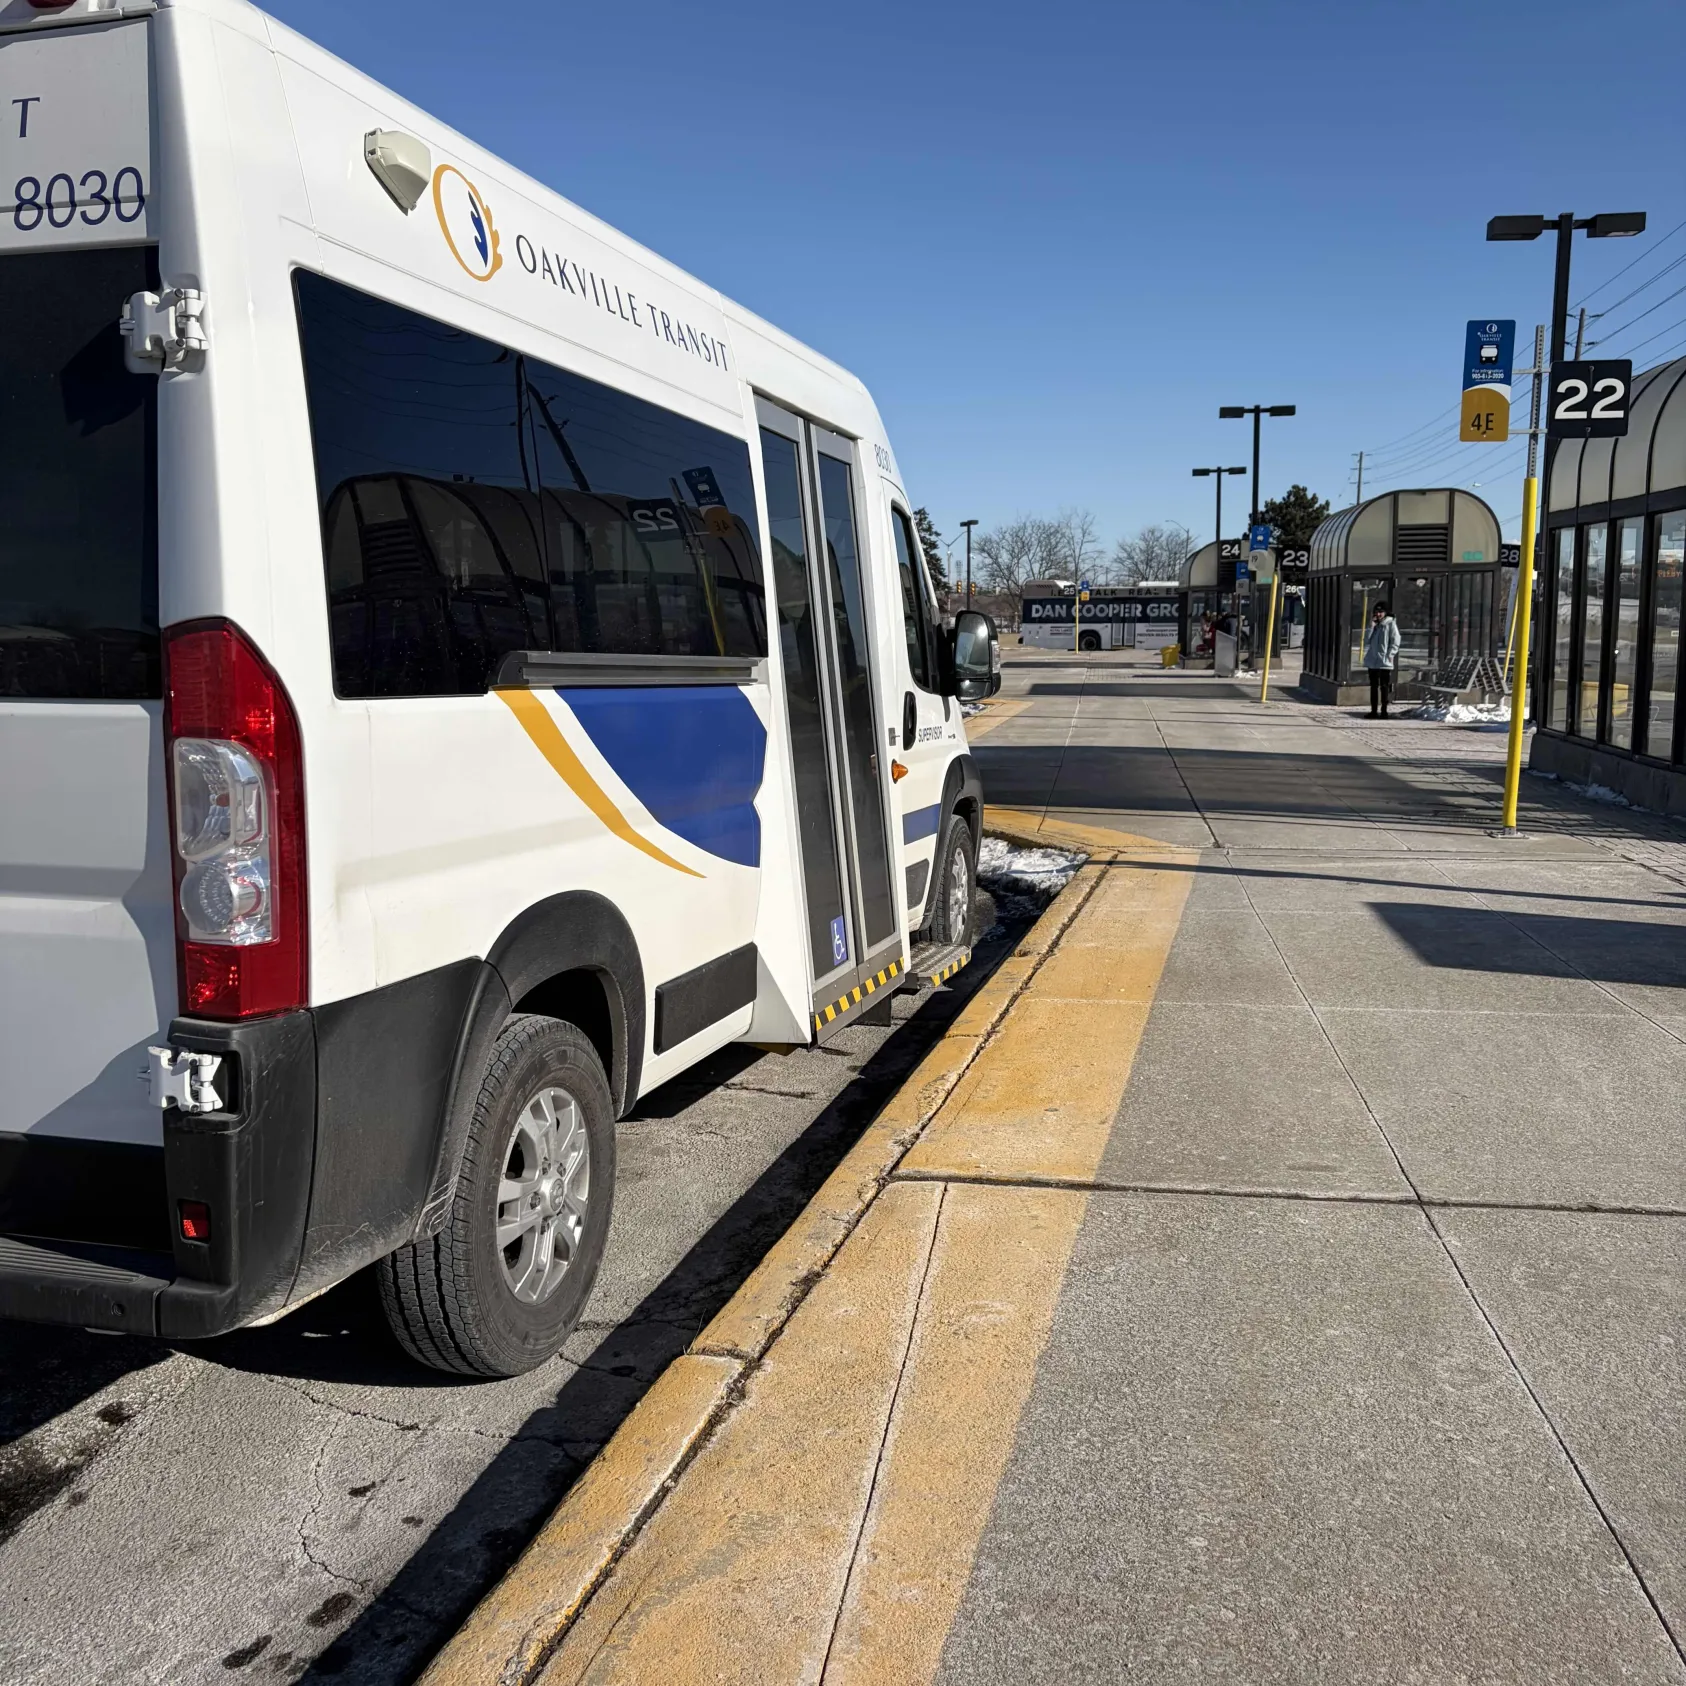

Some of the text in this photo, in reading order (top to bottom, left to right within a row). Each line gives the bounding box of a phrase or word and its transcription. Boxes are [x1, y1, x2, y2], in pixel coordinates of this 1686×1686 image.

[13, 166, 145, 231] 8030
[515, 234, 728, 371] OAKVILLE TRANSIT
[1554, 377, 1625, 420] 22
[1471, 412, 1495, 431] 4E
[1221, 543, 1240, 556] 24
[1282, 549, 1309, 567] 23
[1501, 548, 1520, 563] 28
[1063, 587, 1075, 595] 25
[1285, 585, 1297, 593] 26
[1031, 603, 1067, 618] DAN
[1071, 603, 1142, 618] COOPER
[918, 725, 943, 743] SUPERVISOR
